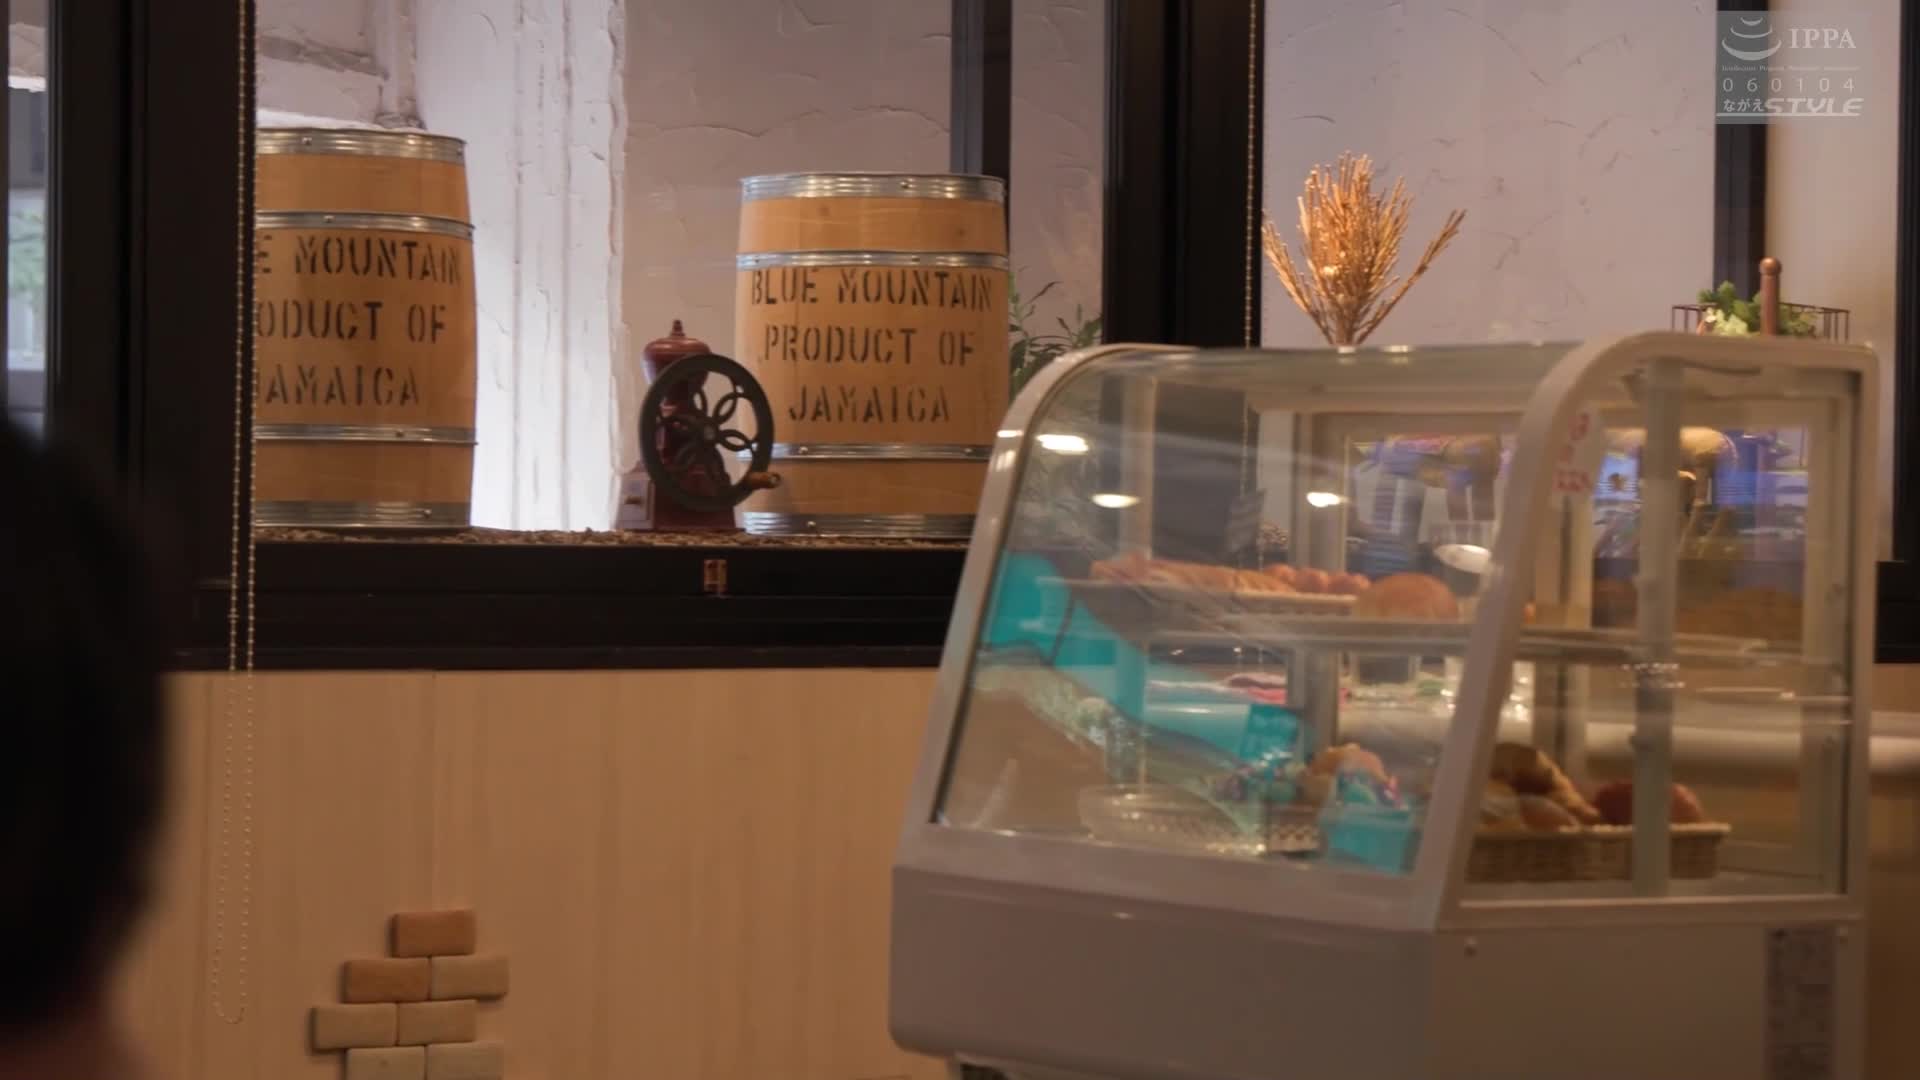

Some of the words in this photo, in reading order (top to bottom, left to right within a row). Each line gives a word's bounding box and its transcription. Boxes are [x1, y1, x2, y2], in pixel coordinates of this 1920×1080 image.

[294, 235, 462, 285] MOUNTAIN
[751, 267, 819, 305] BLUE
[838, 268, 992, 312] MOUNTAIN
[408, 304, 447, 344] OF
[764, 324, 918, 365] PRODUCT
[938, 330, 975, 366] OF
[788, 385, 951, 423] JAMAICA
